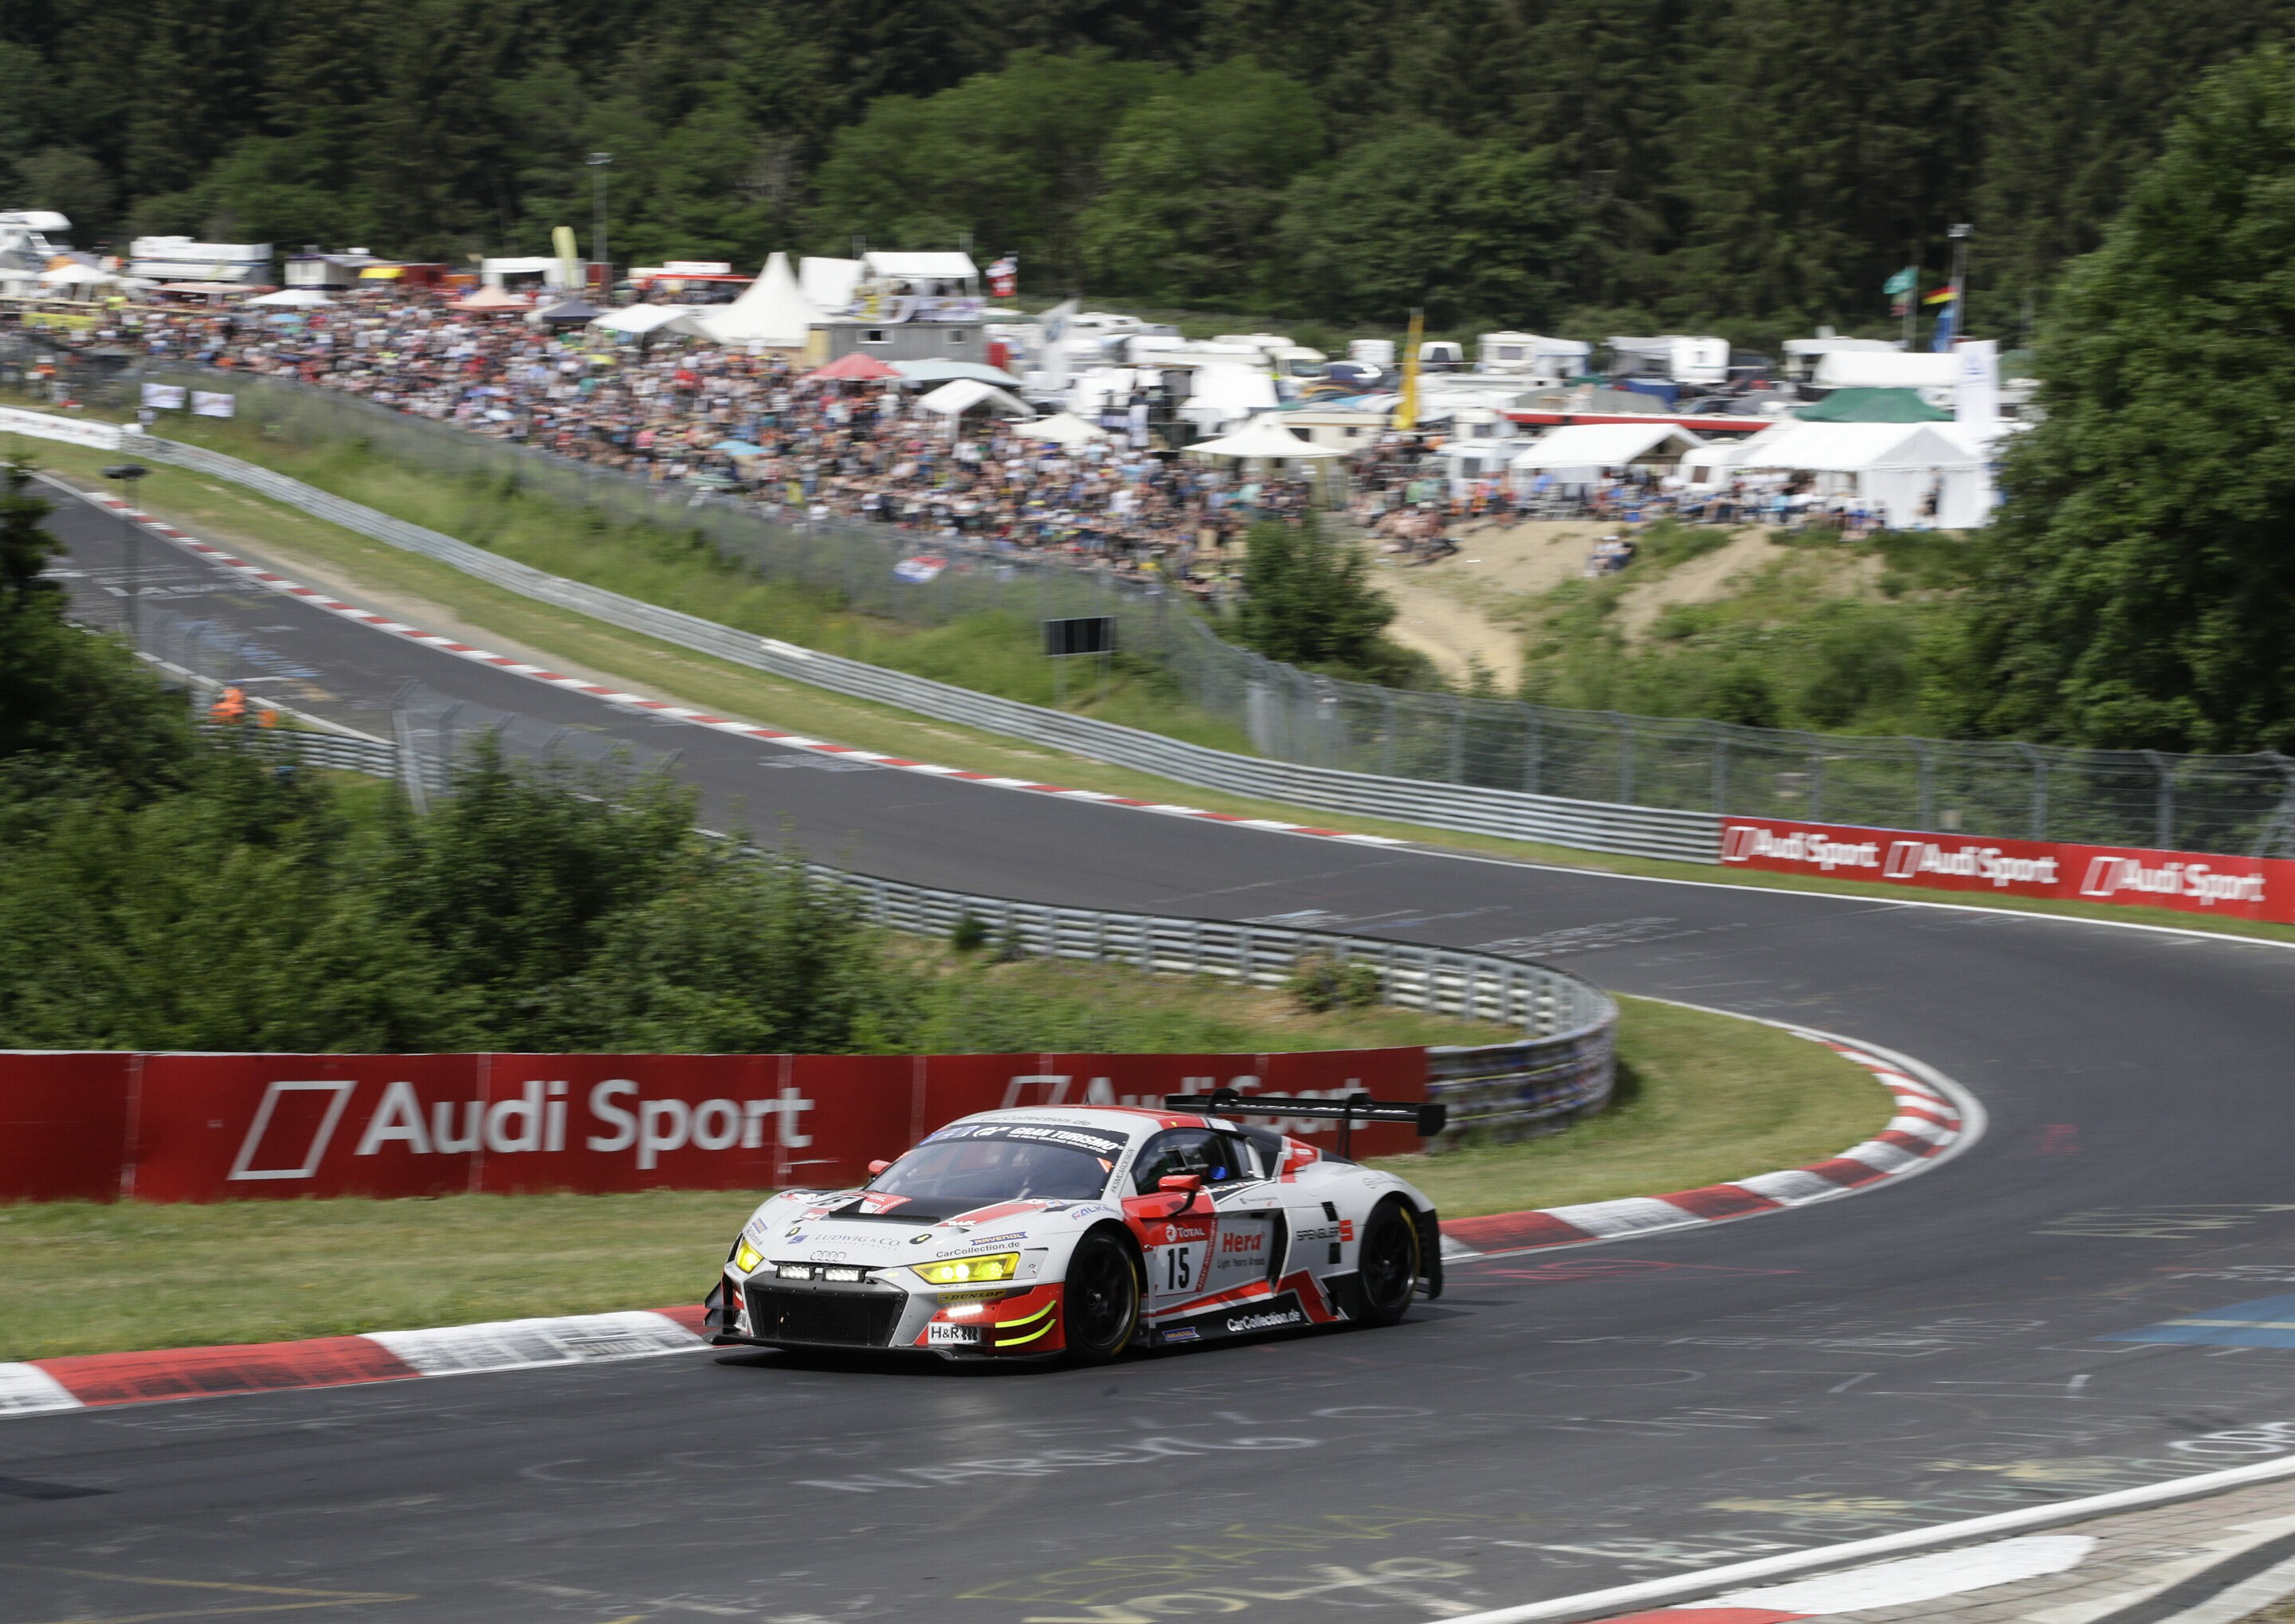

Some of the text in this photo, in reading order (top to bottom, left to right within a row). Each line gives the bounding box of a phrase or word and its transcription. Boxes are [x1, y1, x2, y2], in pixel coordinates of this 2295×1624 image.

[1750, 829, 1880, 870] Audi Sport
[1917, 844, 2058, 886] Audi Sport
[2117, 859, 2266, 905] Audi Sport
[355, 1079, 815, 1169] Audi Sport
[1008, 1127, 1119, 1151] GRAN TURISMO
[814, 1234, 866, 1243] LUDWIG
[975, 1233, 1023, 1245] RAVENOL
[1176, 1227, 1205, 1238] TOTAL
[1222, 1233, 1261, 1253] Hera
[936, 1242, 1020, 1258] CarCollection.de
[1167, 1247, 1190, 1290] 15
[950, 1290, 1004, 1301] DUNLOP
[1226, 1308, 1300, 1332] CarCollection.de
[931, 1326, 960, 1340] H&R
